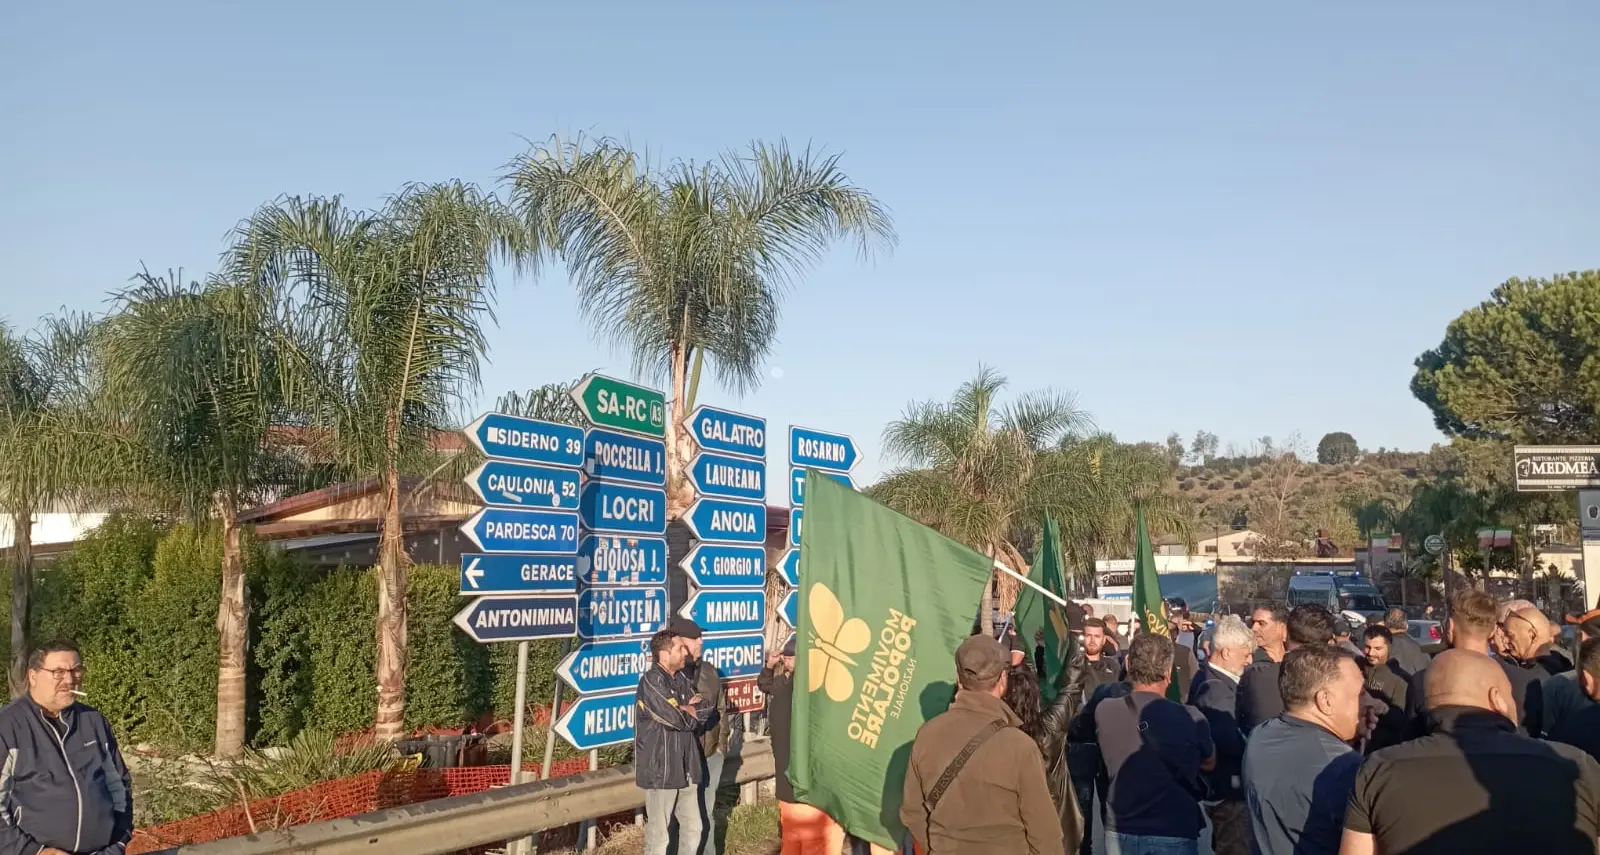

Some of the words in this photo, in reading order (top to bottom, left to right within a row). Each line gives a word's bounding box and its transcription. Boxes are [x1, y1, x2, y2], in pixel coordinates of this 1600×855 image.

[597, 389, 647, 422] SA-RC
[652, 405, 662, 423] A3
[498, 428, 559, 452] SIDERNO
[566, 439, 581, 455] 39
[701, 418, 764, 448] GALATRO
[594, 440, 651, 473] ROCCELLA
[655, 451, 665, 476] J.
[798, 436, 846, 463] ROSARNO
[705, 463, 761, 491] LAUREANA
[1532, 462, 1599, 474] MEDMEA
[487, 475, 555, 495] CAULONIA
[562, 481, 576, 497] 52
[602, 495, 654, 522] LOCRI
[485, 521, 556, 540] PARDESCA
[560, 525, 575, 541] 70
[710, 510, 757, 534] ANOIA
[593, 547, 645, 572] GIOIOSA
[651, 549, 661, 573] J.
[700, 556, 710, 576] S.
[713, 556, 751, 576] GIORGIO
[521, 564, 574, 582] GERACE
[475, 607, 574, 629] ANTONIMINA
[589, 600, 661, 625] POLISTENA
[706, 601, 759, 623] MAMMOLA
[703, 644, 762, 669] GIFFONE
[742, 683, 751, 695] di
[584, 705, 635, 735] MELICU
